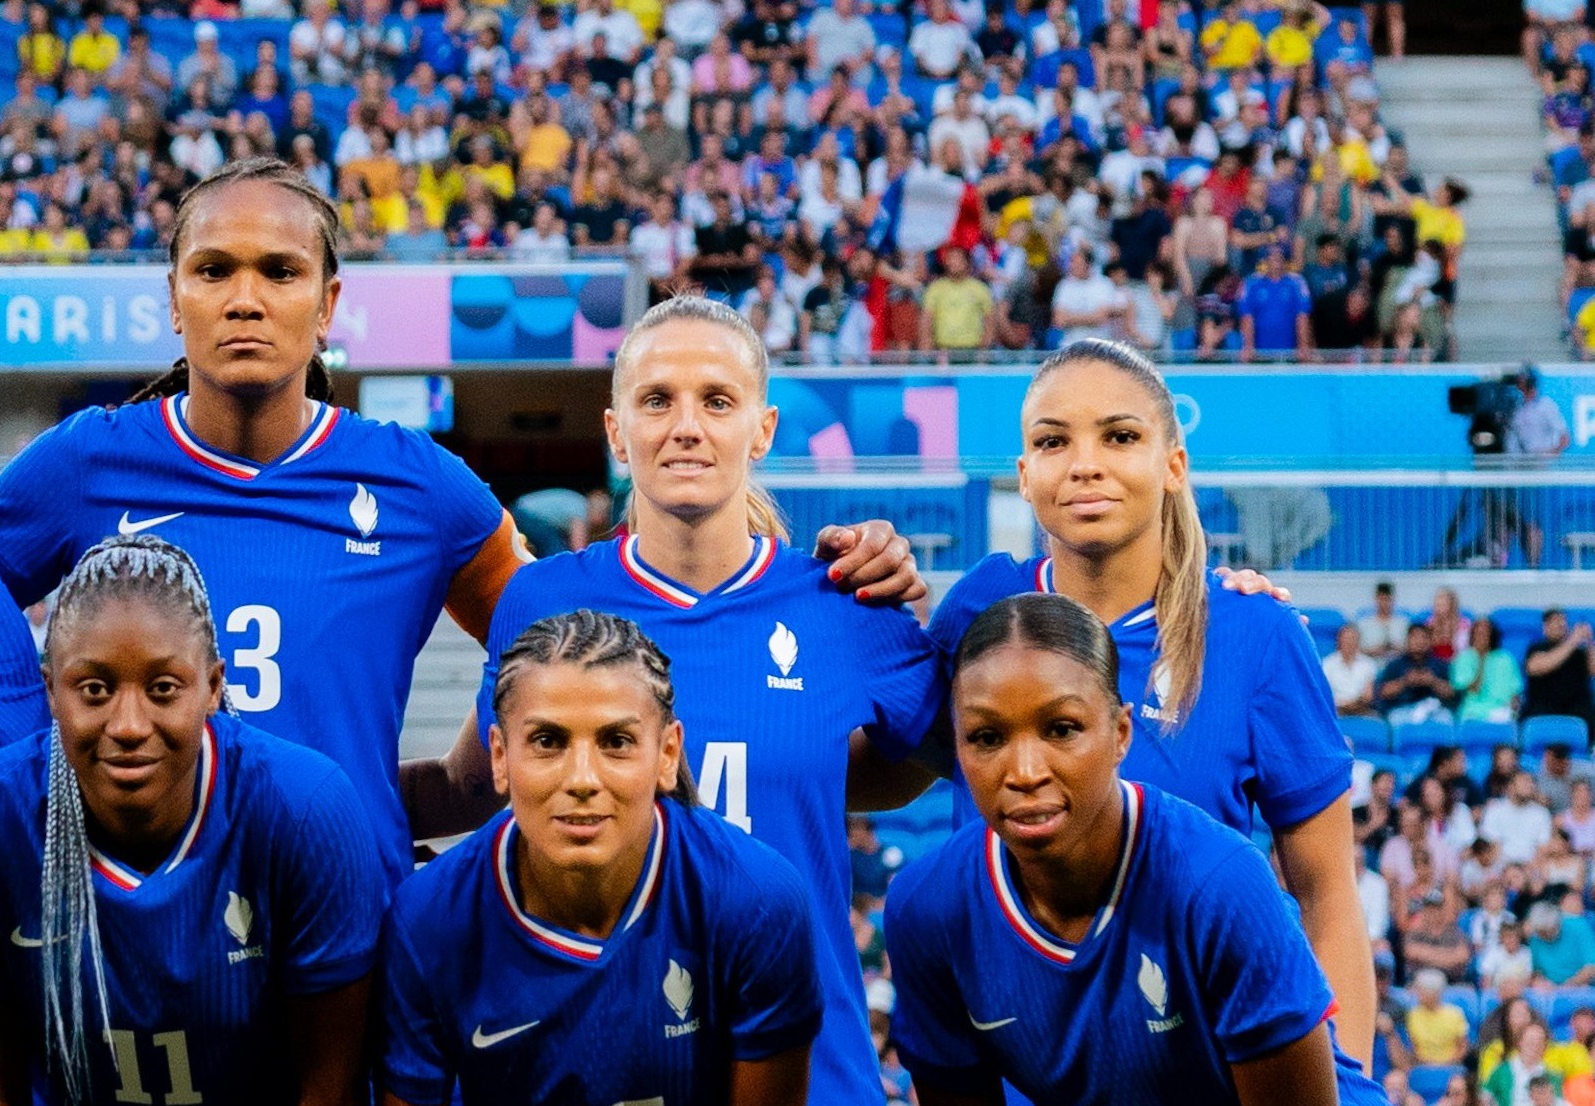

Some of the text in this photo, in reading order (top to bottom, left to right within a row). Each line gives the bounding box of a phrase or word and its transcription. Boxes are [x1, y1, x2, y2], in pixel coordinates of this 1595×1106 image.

[345, 538, 381, 556] FRANCE
[226, 604, 282, 712] 3
[767, 674, 804, 691] FRANCE
[227, 944, 264, 965] FRANCE
[664, 1016, 701, 1039] FRANCE
[102, 1028, 203, 1106] 11
